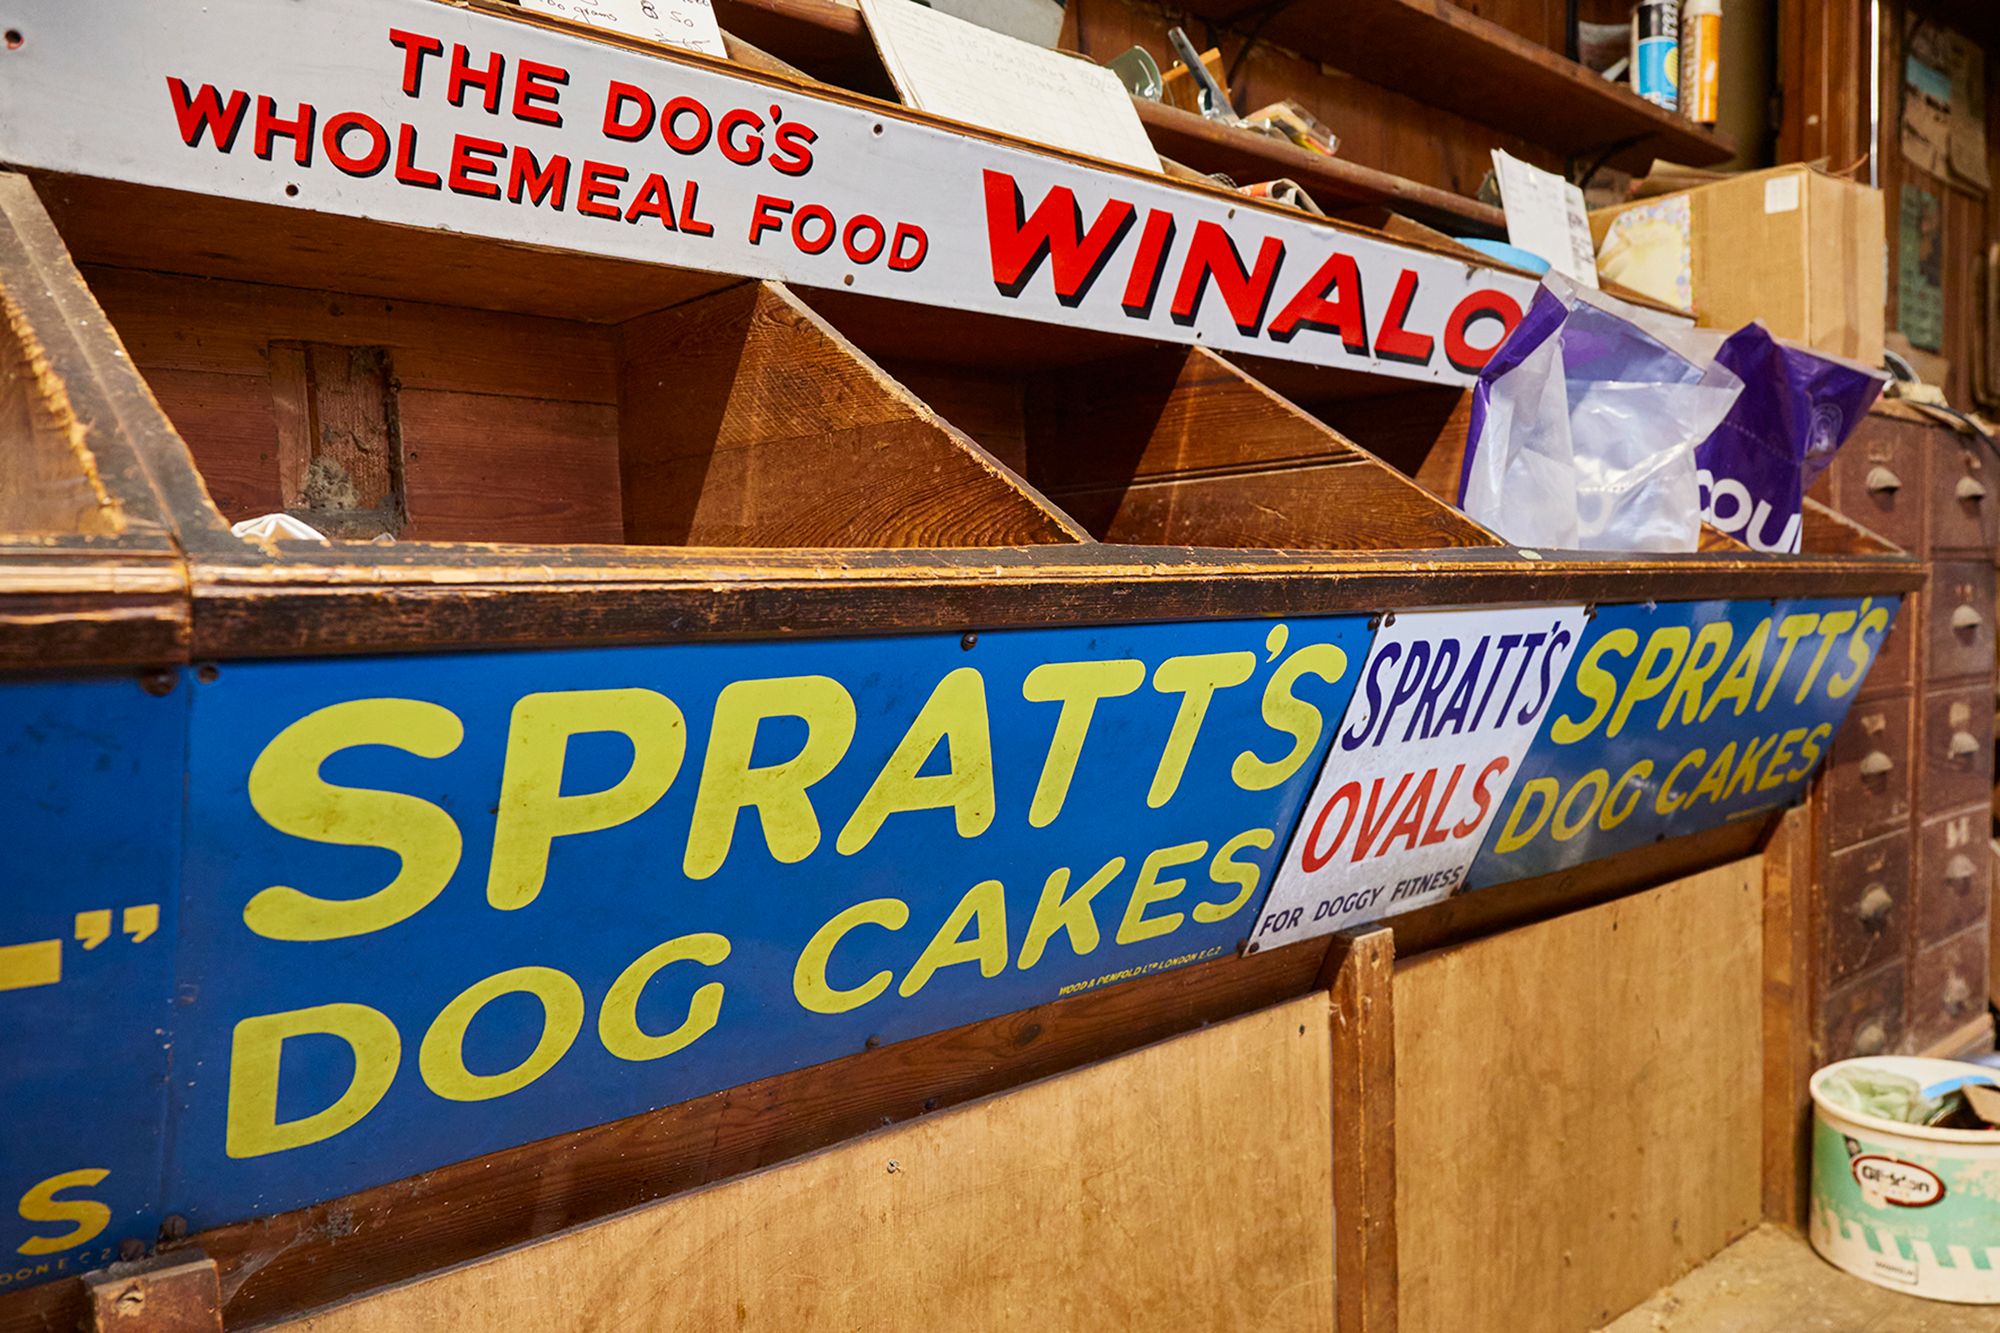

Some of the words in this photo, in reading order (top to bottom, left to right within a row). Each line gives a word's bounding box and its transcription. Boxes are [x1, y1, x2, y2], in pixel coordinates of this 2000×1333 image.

[389, 28, 569, 128] THE
[602, 80, 818, 177] DOG'S
[166, 77, 714, 237] WHOLEMEAL
[749, 194, 928, 272] FOOD
[1341, 620, 1571, 751] SPRATT'S
[1551, 597, 1890, 744] SPRATT'S
[244, 625, 1347, 941] SPRATT'S
[1301, 755, 1510, 874] OVALS
[1494, 758, 1655, 855] DOG
[1655, 722, 1833, 815] CAKES
[1258, 906, 1304, 937] FOR
[1313, 886, 1385, 922] DOGGY
[1390, 865, 1464, 902] FITNESS
[227, 932, 731, 1159] DOG
[793, 827, 1275, 1014] CAKES
[1058, 981, 1088, 997] WOOD
[1096, 965, 1142, 986] PENFOLD
[1158, 952, 1197, 970] LONDON
